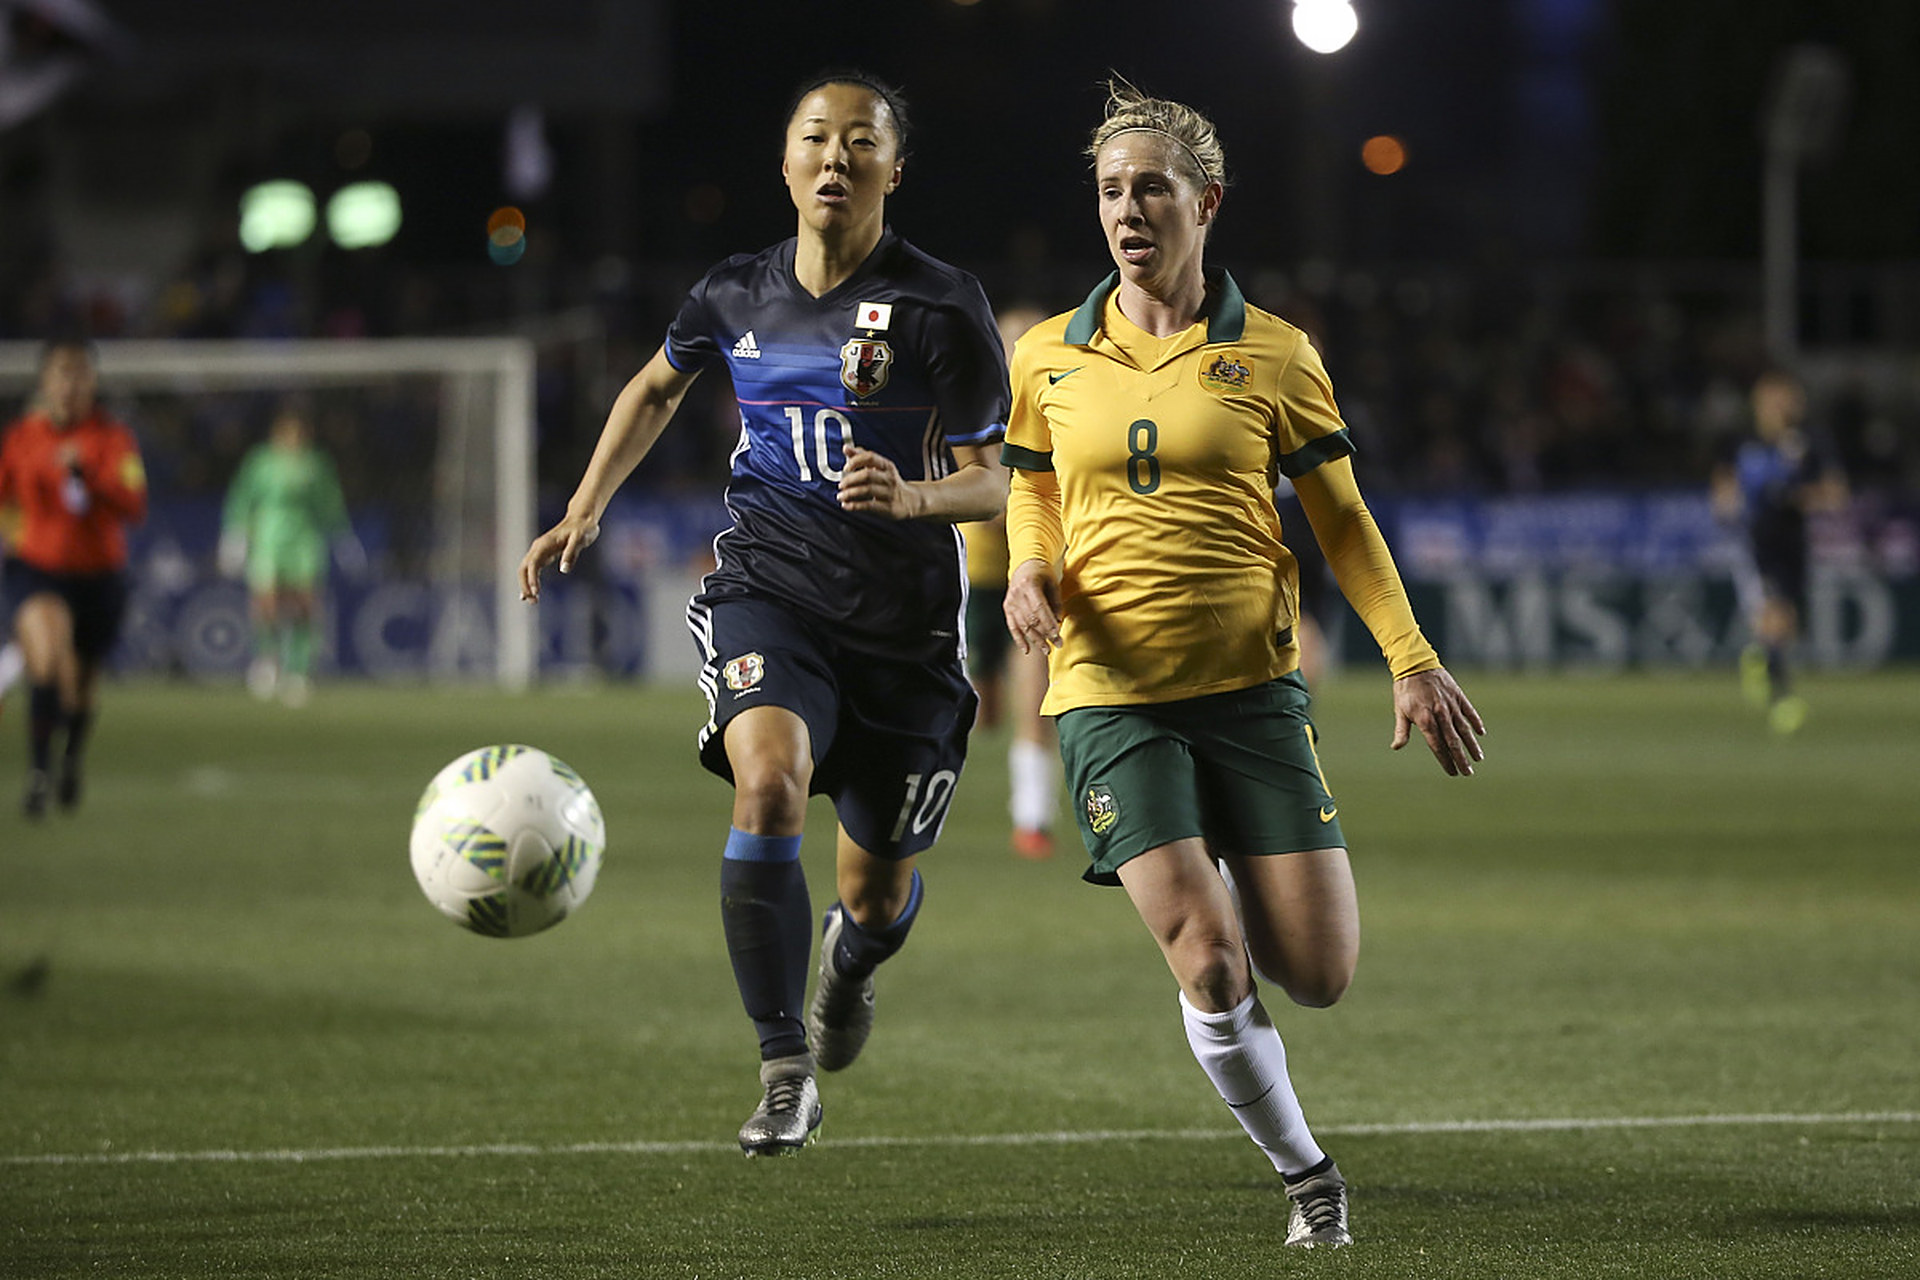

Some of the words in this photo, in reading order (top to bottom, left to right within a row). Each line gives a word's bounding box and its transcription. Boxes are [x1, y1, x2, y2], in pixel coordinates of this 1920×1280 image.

[784, 406, 855, 482] 10
[1127, 419, 1161, 495] 8
[352, 583, 646, 677] CAD
[890, 769, 956, 843] 10
